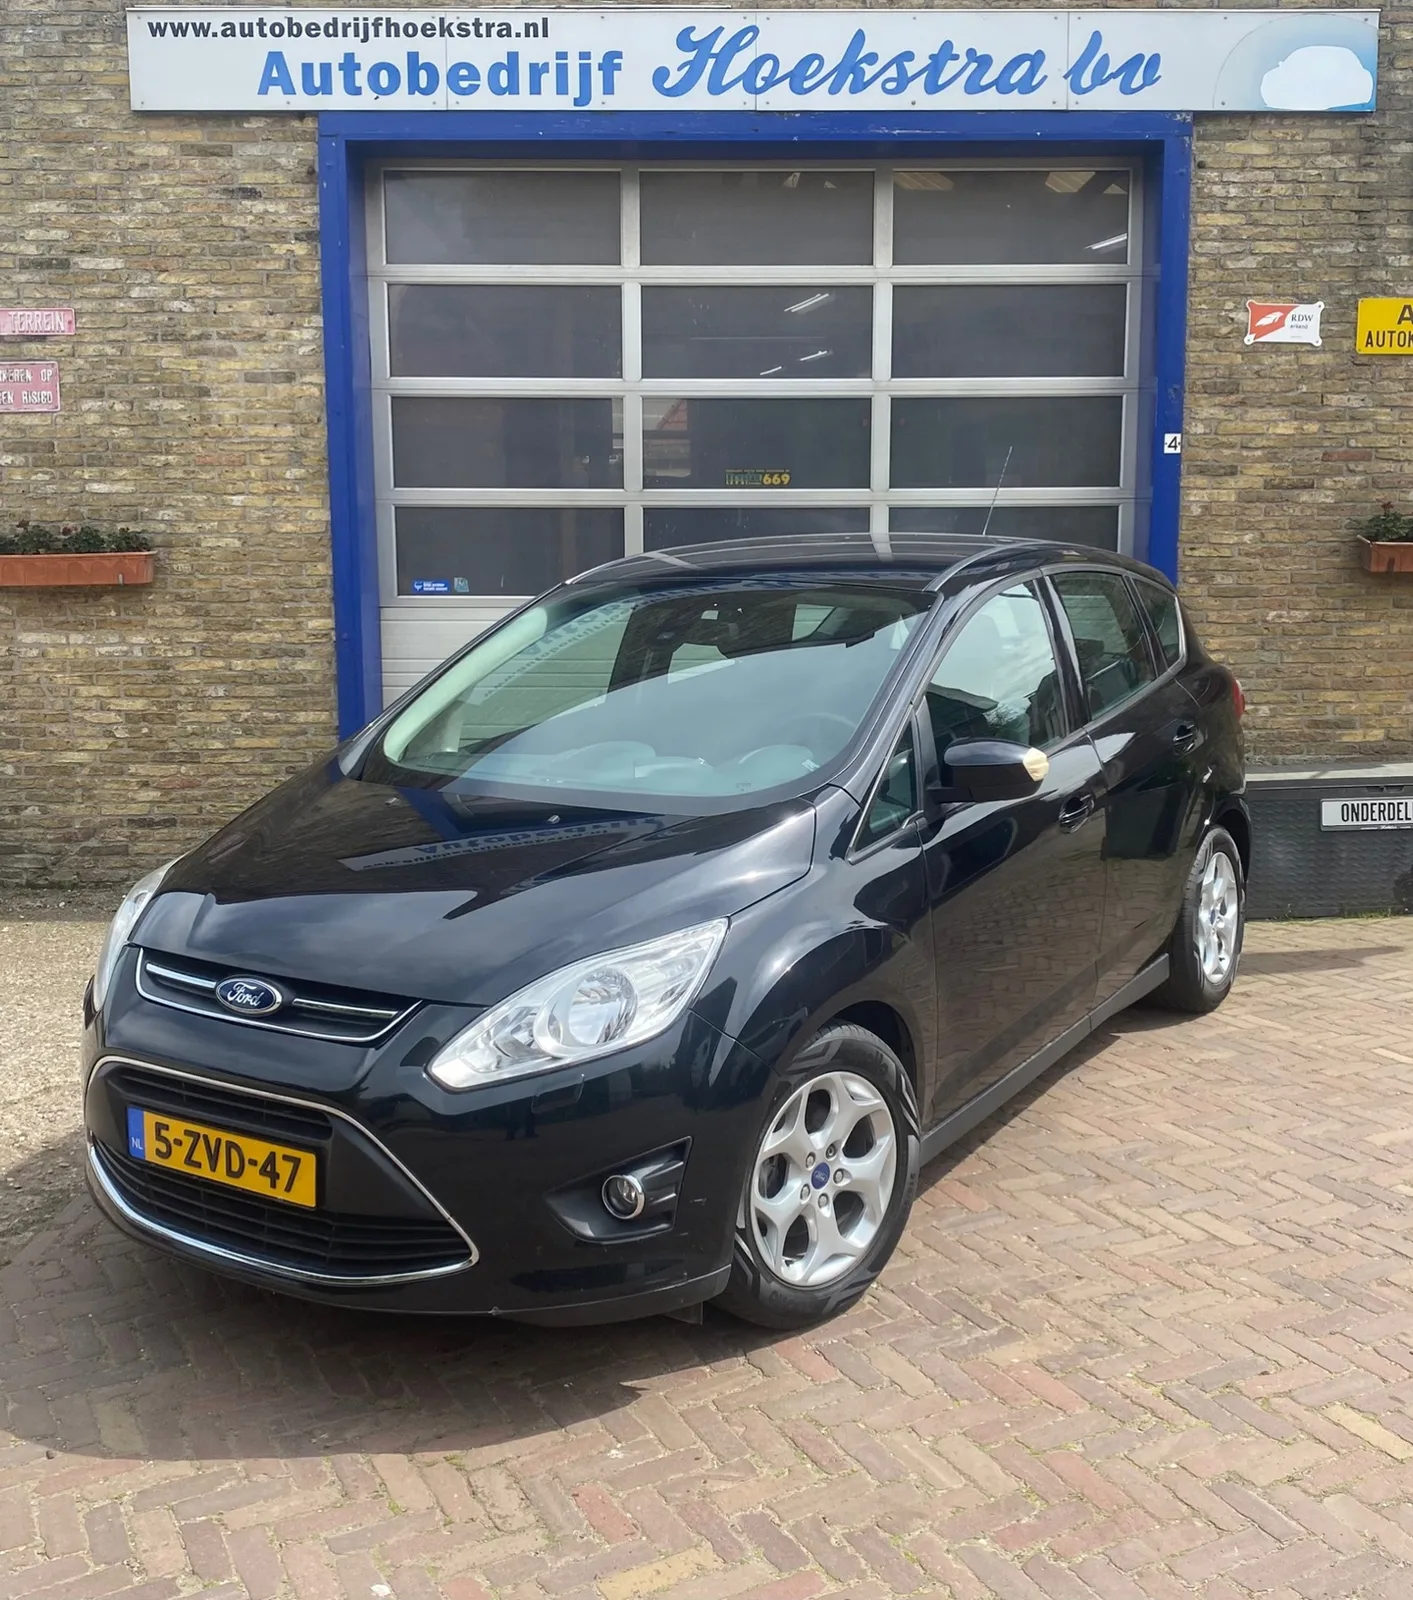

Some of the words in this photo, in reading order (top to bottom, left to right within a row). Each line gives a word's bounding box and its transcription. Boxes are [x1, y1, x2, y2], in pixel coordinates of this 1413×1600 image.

[147, 16, 550, 43] www.autobedrijfhoekstra.nl
[257, 51, 624, 107] Autobedrijf
[651, 25, 1048, 97] Hoekstra
[1063, 30, 1163, 97] bv
[8, 311, 65, 333] TERREIN
[1291, 314, 1314, 322] RDW
[0, 368, 33, 383] KEREN
[40, 368, 53, 382] OP
[0, 391, 14, 404] EN
[22, 391, 53, 404] RISICO
[1167, 435, 1178, 451] 4
[762, 473, 791, 485] 669
[1341, 801, 1413, 822] ONDERDEL
[226, 981, 263, 1008] Ford
[131, 1136, 144, 1150] NL
[154, 1121, 302, 1193] 5-ZVD-47
